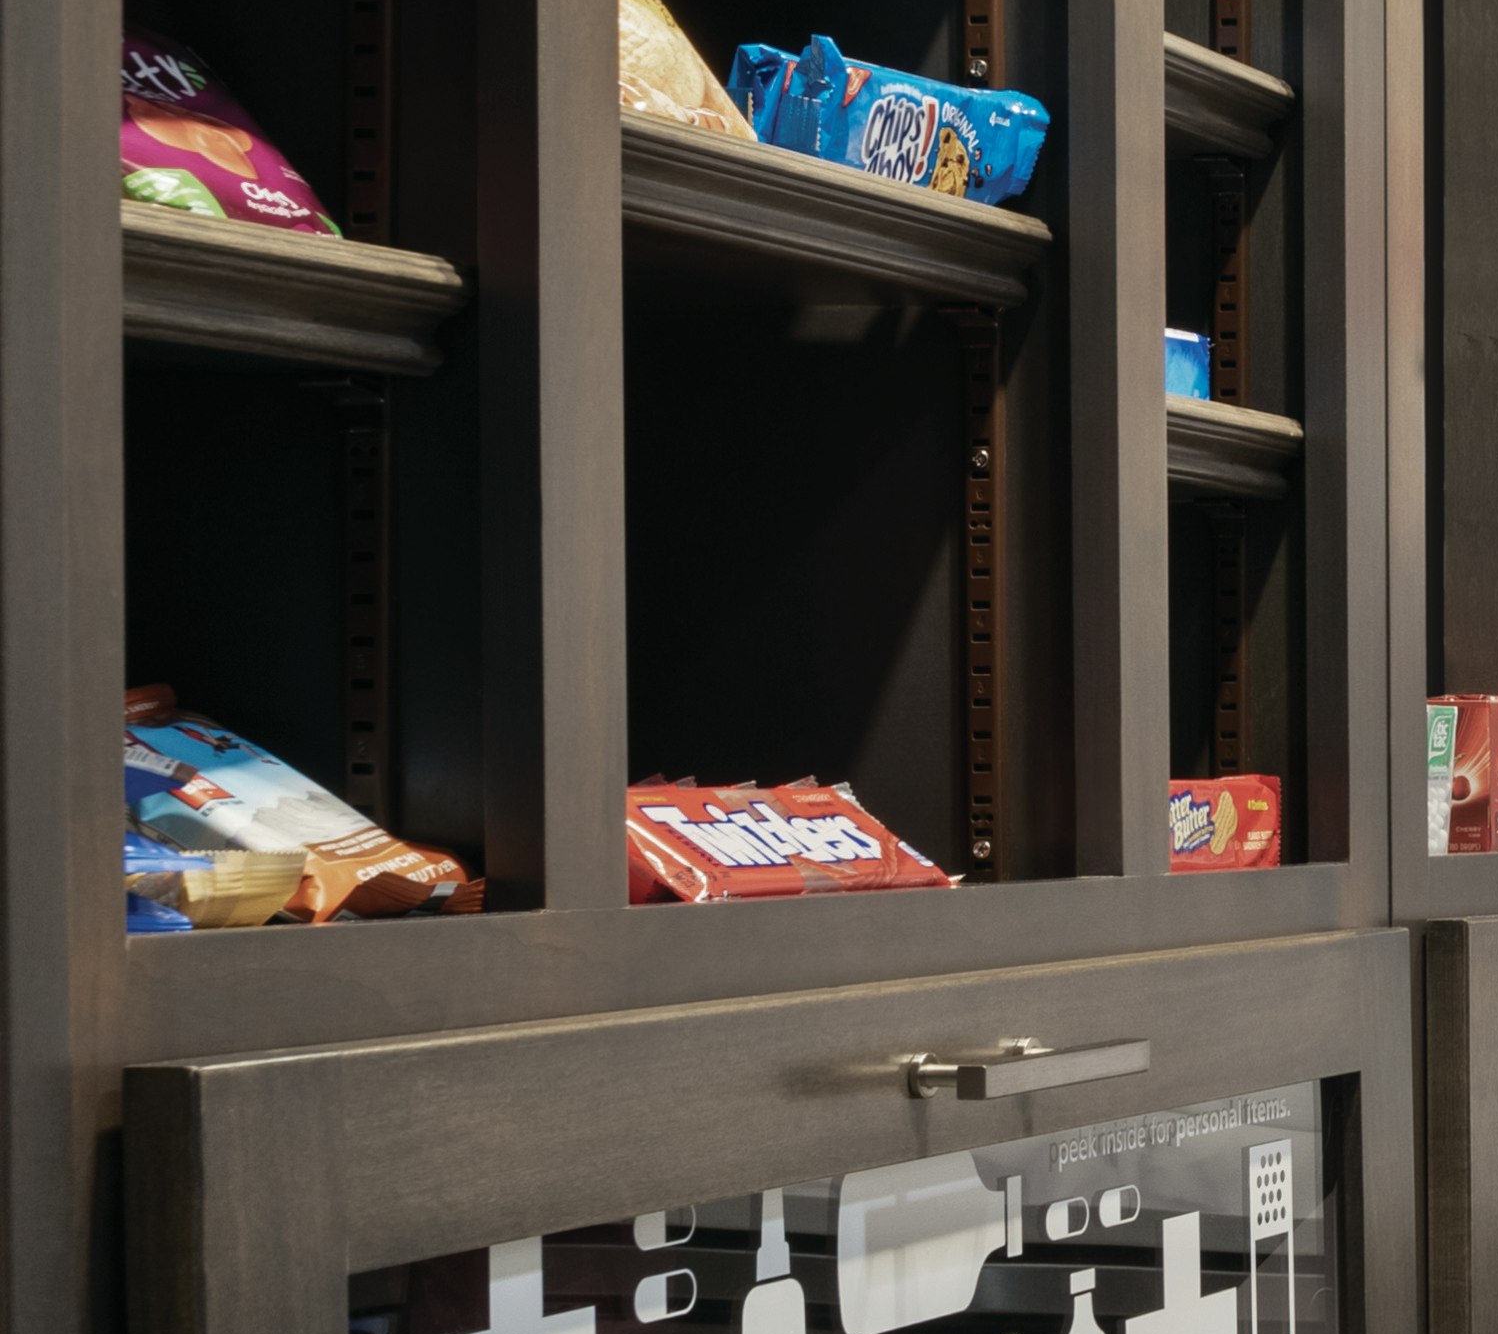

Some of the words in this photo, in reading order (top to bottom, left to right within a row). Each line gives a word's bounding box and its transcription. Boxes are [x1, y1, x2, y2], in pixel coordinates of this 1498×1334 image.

[864, 100, 926, 159] Chips
[941, 101, 981, 153] ORIGINAL
[1433, 734, 1448, 749] tac
[1437, 719, 1449, 735] tic
[1173, 804, 1211, 851] Butter
[1058, 1134, 1098, 1172] peek
[1101, 1123, 1147, 1156] inside
[1150, 1117, 1172, 1145] for
[1175, 1099, 1243, 1147] personal
[1246, 1096, 1292, 1125] items.
